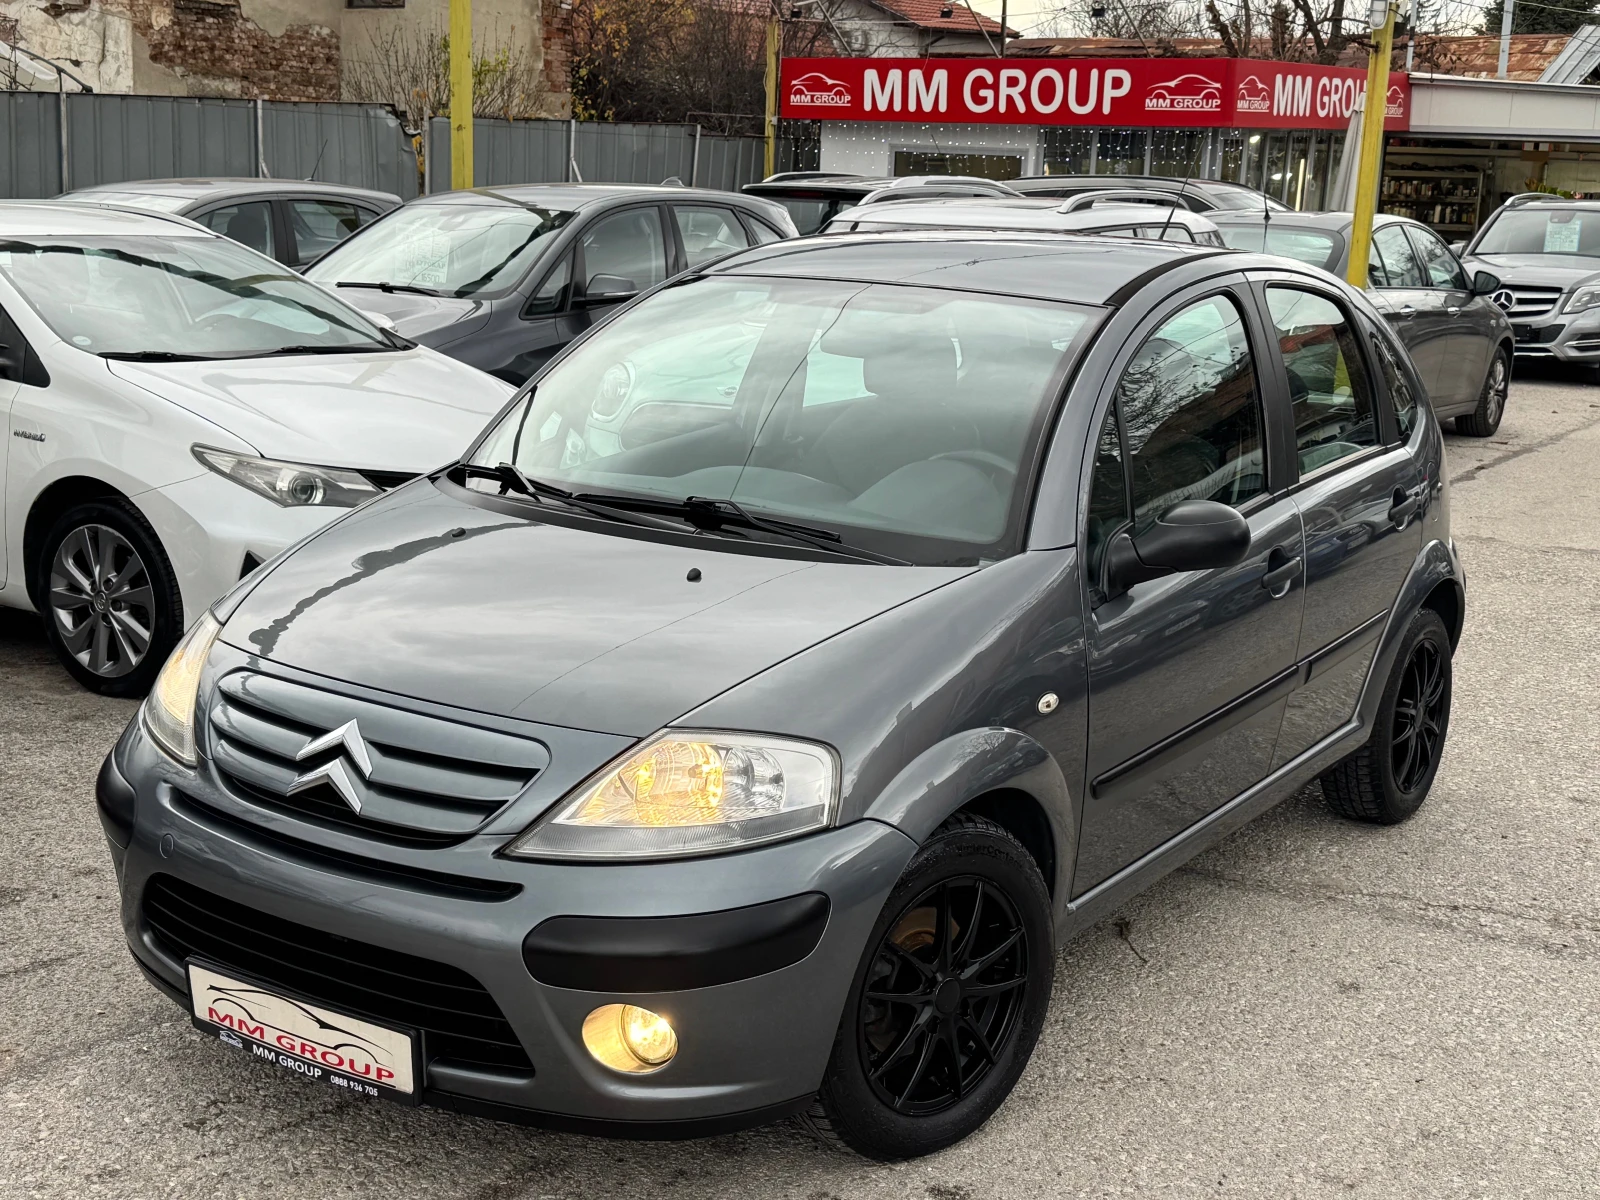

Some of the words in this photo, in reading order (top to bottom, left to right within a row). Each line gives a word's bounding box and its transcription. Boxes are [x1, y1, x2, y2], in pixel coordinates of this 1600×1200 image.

[789, 94, 812, 103] MM
[813, 94, 852, 104] GROUP
[864, 69, 948, 113] MM
[963, 68, 1132, 115] GROUP
[1144, 98, 1171, 108] MM
[1173, 98, 1221, 109] GROUP
[1236, 99, 1249, 109] MM
[1249, 100, 1270, 110] GROUP
[1273, 73, 1313, 118] MM
[1316, 76, 1367, 119] GROU
[208, 1006, 265, 1040] MM
[276, 1035, 395, 1081] GROUP
[252, 1043, 276, 1062] MM
[279, 1055, 322, 1078] GROUP
[330, 1074, 349, 1087] 0888
[349, 1080, 363, 1092] 936
[364, 1085, 379, 1097] 705
